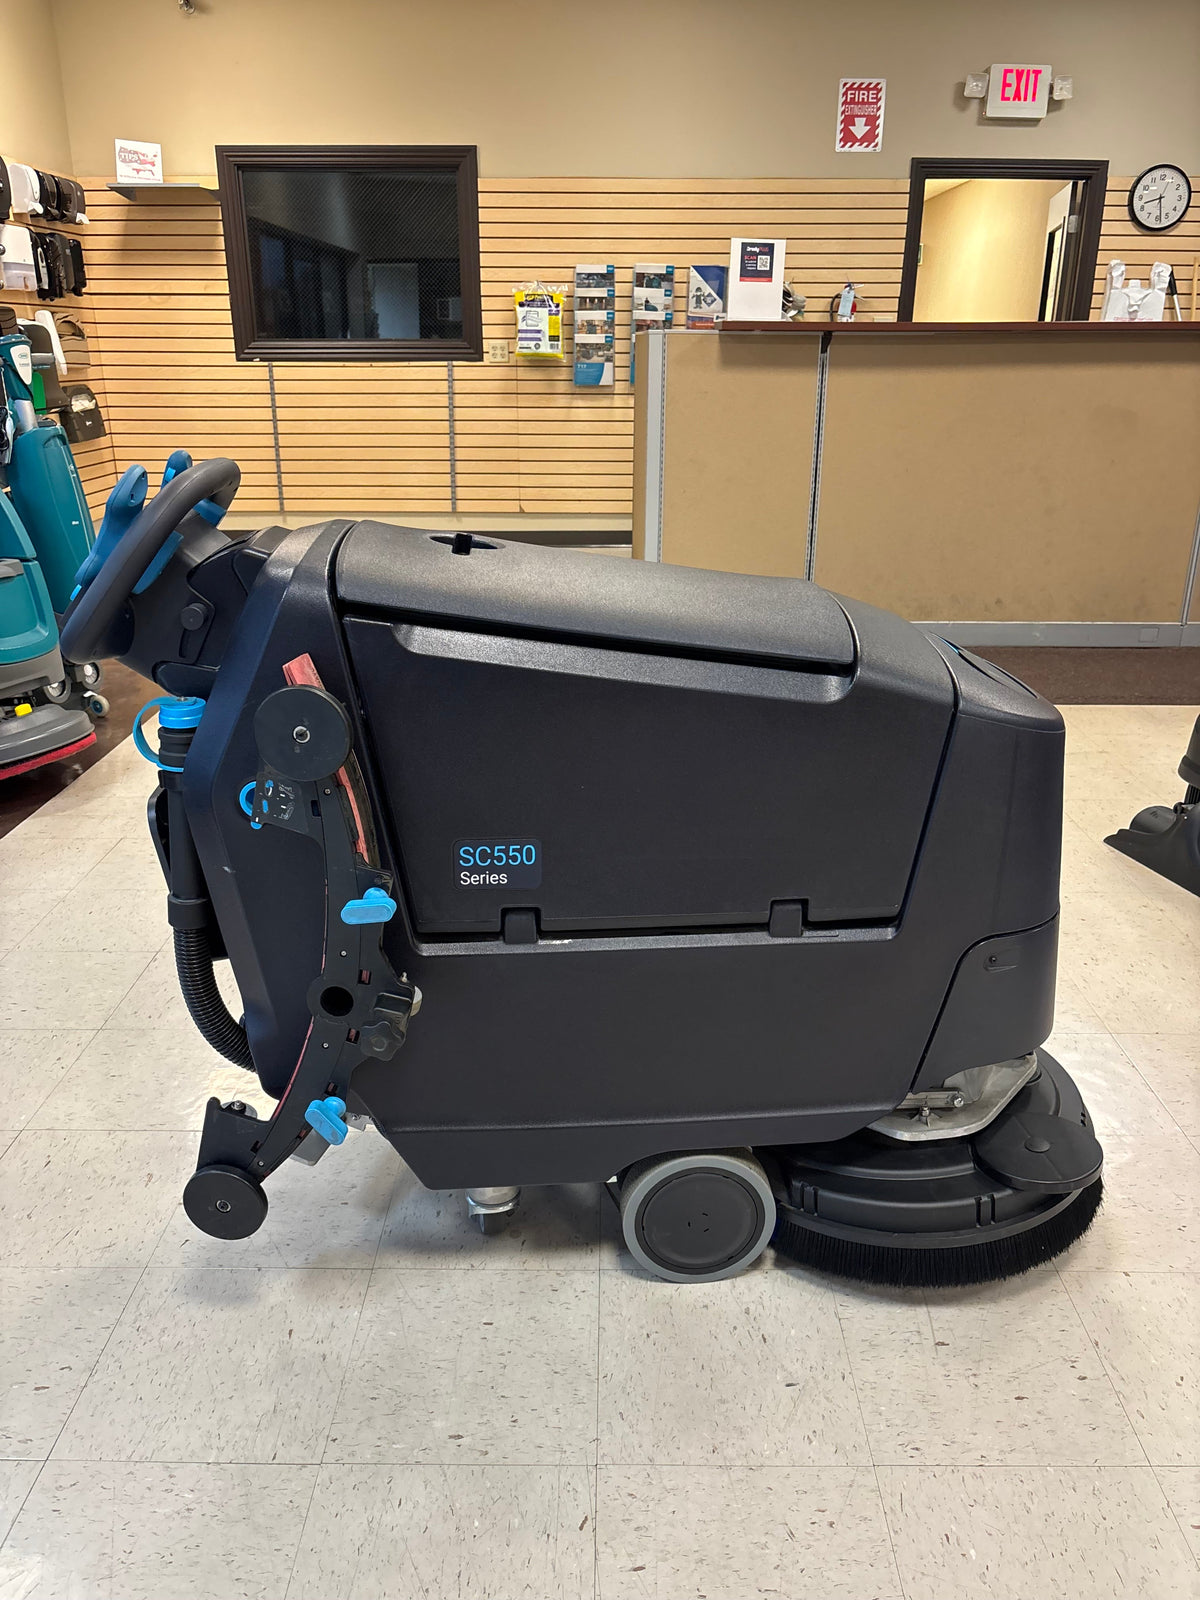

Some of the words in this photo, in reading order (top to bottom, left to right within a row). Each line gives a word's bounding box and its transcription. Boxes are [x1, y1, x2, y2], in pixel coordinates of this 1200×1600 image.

[1000, 68, 1043, 102] EXIT
[847, 90, 877, 102] FIRE
[844, 104, 878, 115] EXTINGUISHER
[1175, 183, 1181, 191] 2
[459, 844, 536, 867] SC550
[460, 870, 508, 886] Series
